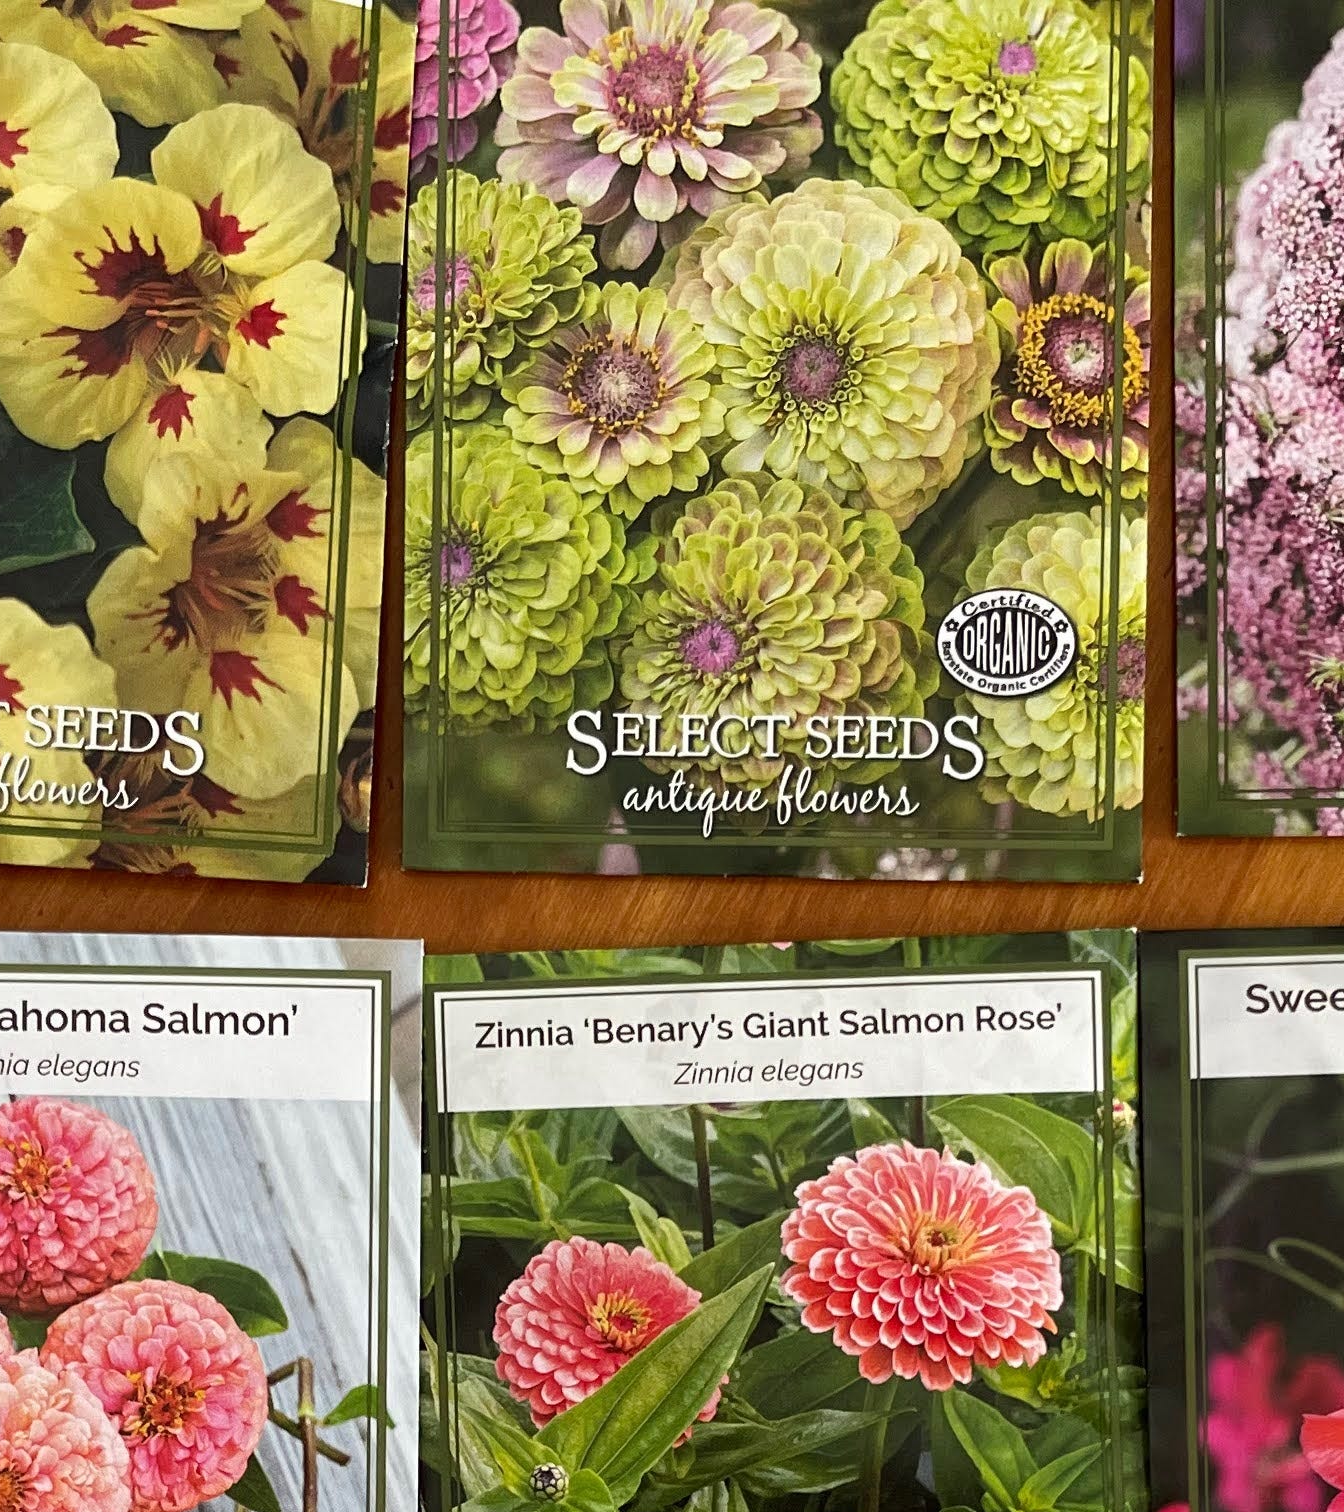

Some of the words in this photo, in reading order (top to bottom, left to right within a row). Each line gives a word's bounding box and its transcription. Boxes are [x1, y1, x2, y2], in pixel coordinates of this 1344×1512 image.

[962, 594, 1054, 619] Certified
[963, 611, 1050, 674] ORGANIC
[24, 704, 204, 776] SEEDS
[566, 710, 791, 775] SELECT
[805, 716, 984, 780] SEEDS
[623, 770, 768, 832] antique
[777, 765, 919, 824] flowers
[143, 1004, 297, 1036] Salmon’
[474, 1022, 574, 1048] Zinnia
[584, 1014, 733, 1048] ‘Benary’s
[743, 1012, 830, 1038] Giant
[839, 1008, 963, 1036] Salmon
[976, 1004, 1061, 1032] Rose’
[37, 1053, 140, 1082] elegans
[674, 1061, 753, 1086] Zinnia
[761, 1058, 864, 1086] elegans
